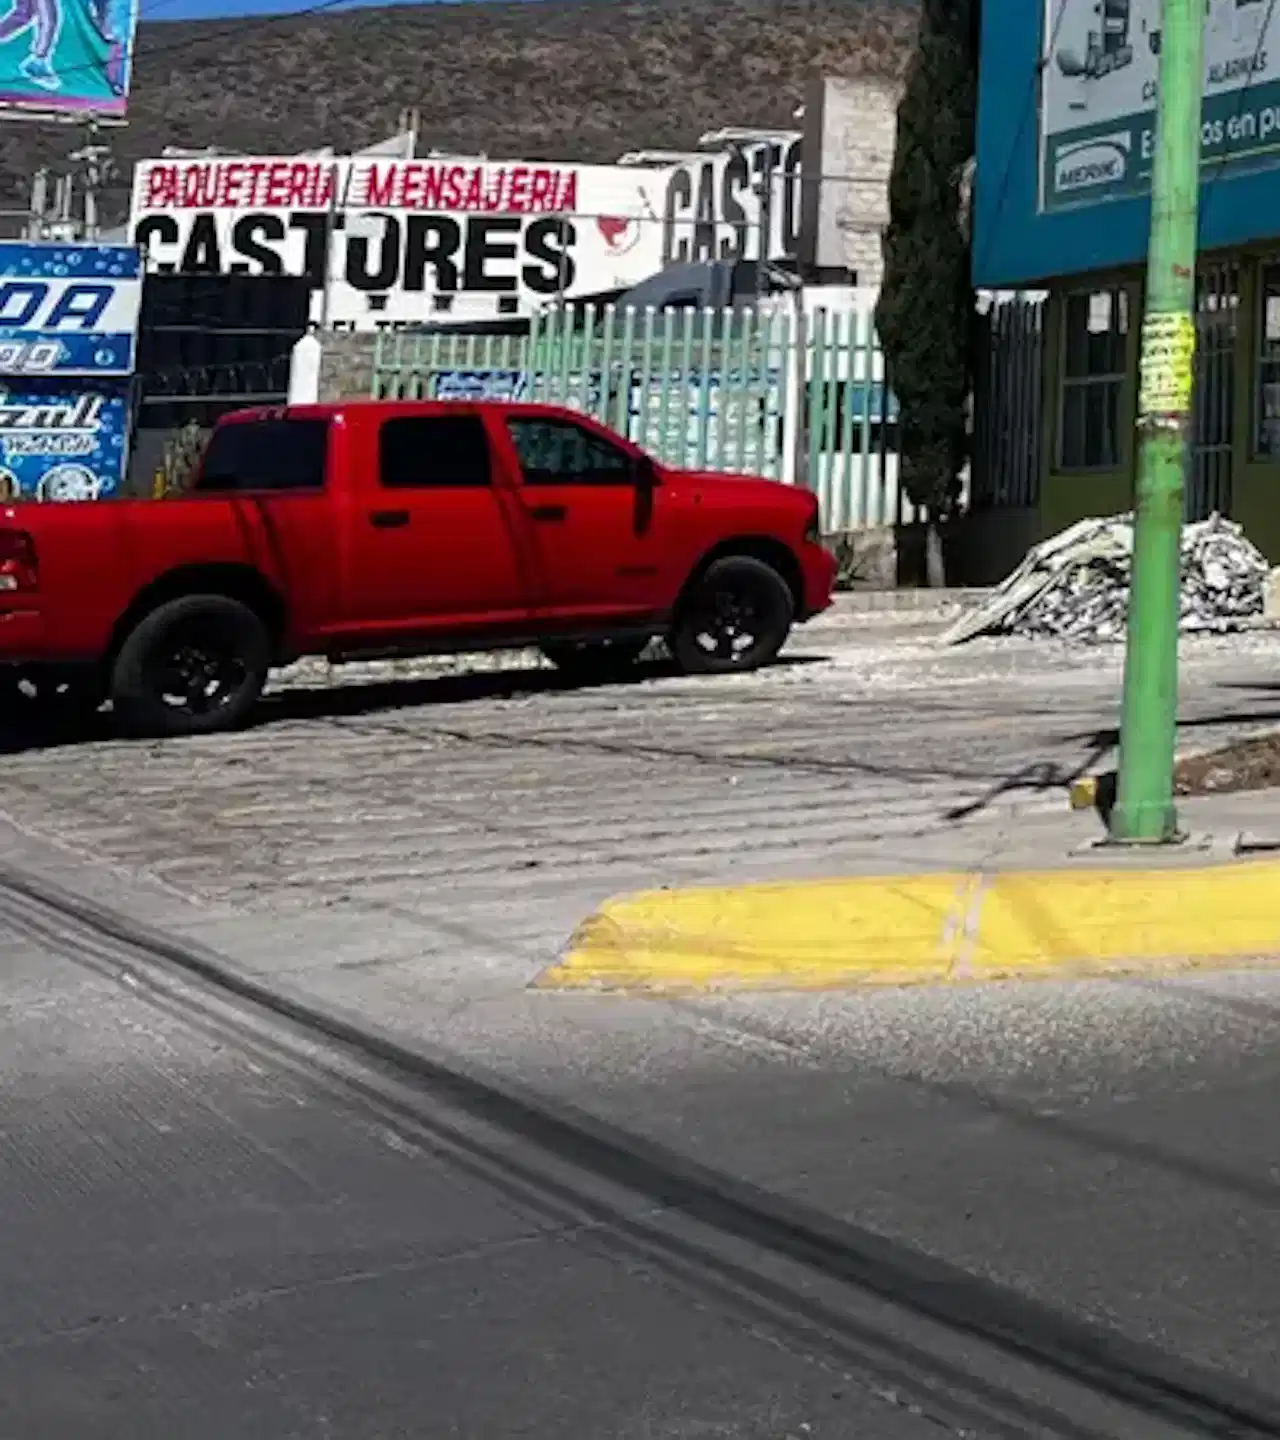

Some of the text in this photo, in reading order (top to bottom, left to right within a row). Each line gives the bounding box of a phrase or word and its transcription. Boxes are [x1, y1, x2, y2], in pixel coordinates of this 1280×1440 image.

[1227, 113, 1257, 140] en
[139, 162, 338, 209] PAQUETERIA
[364, 163, 579, 213] MENSAJERIA
[134, 211, 578, 294] CASTORES
